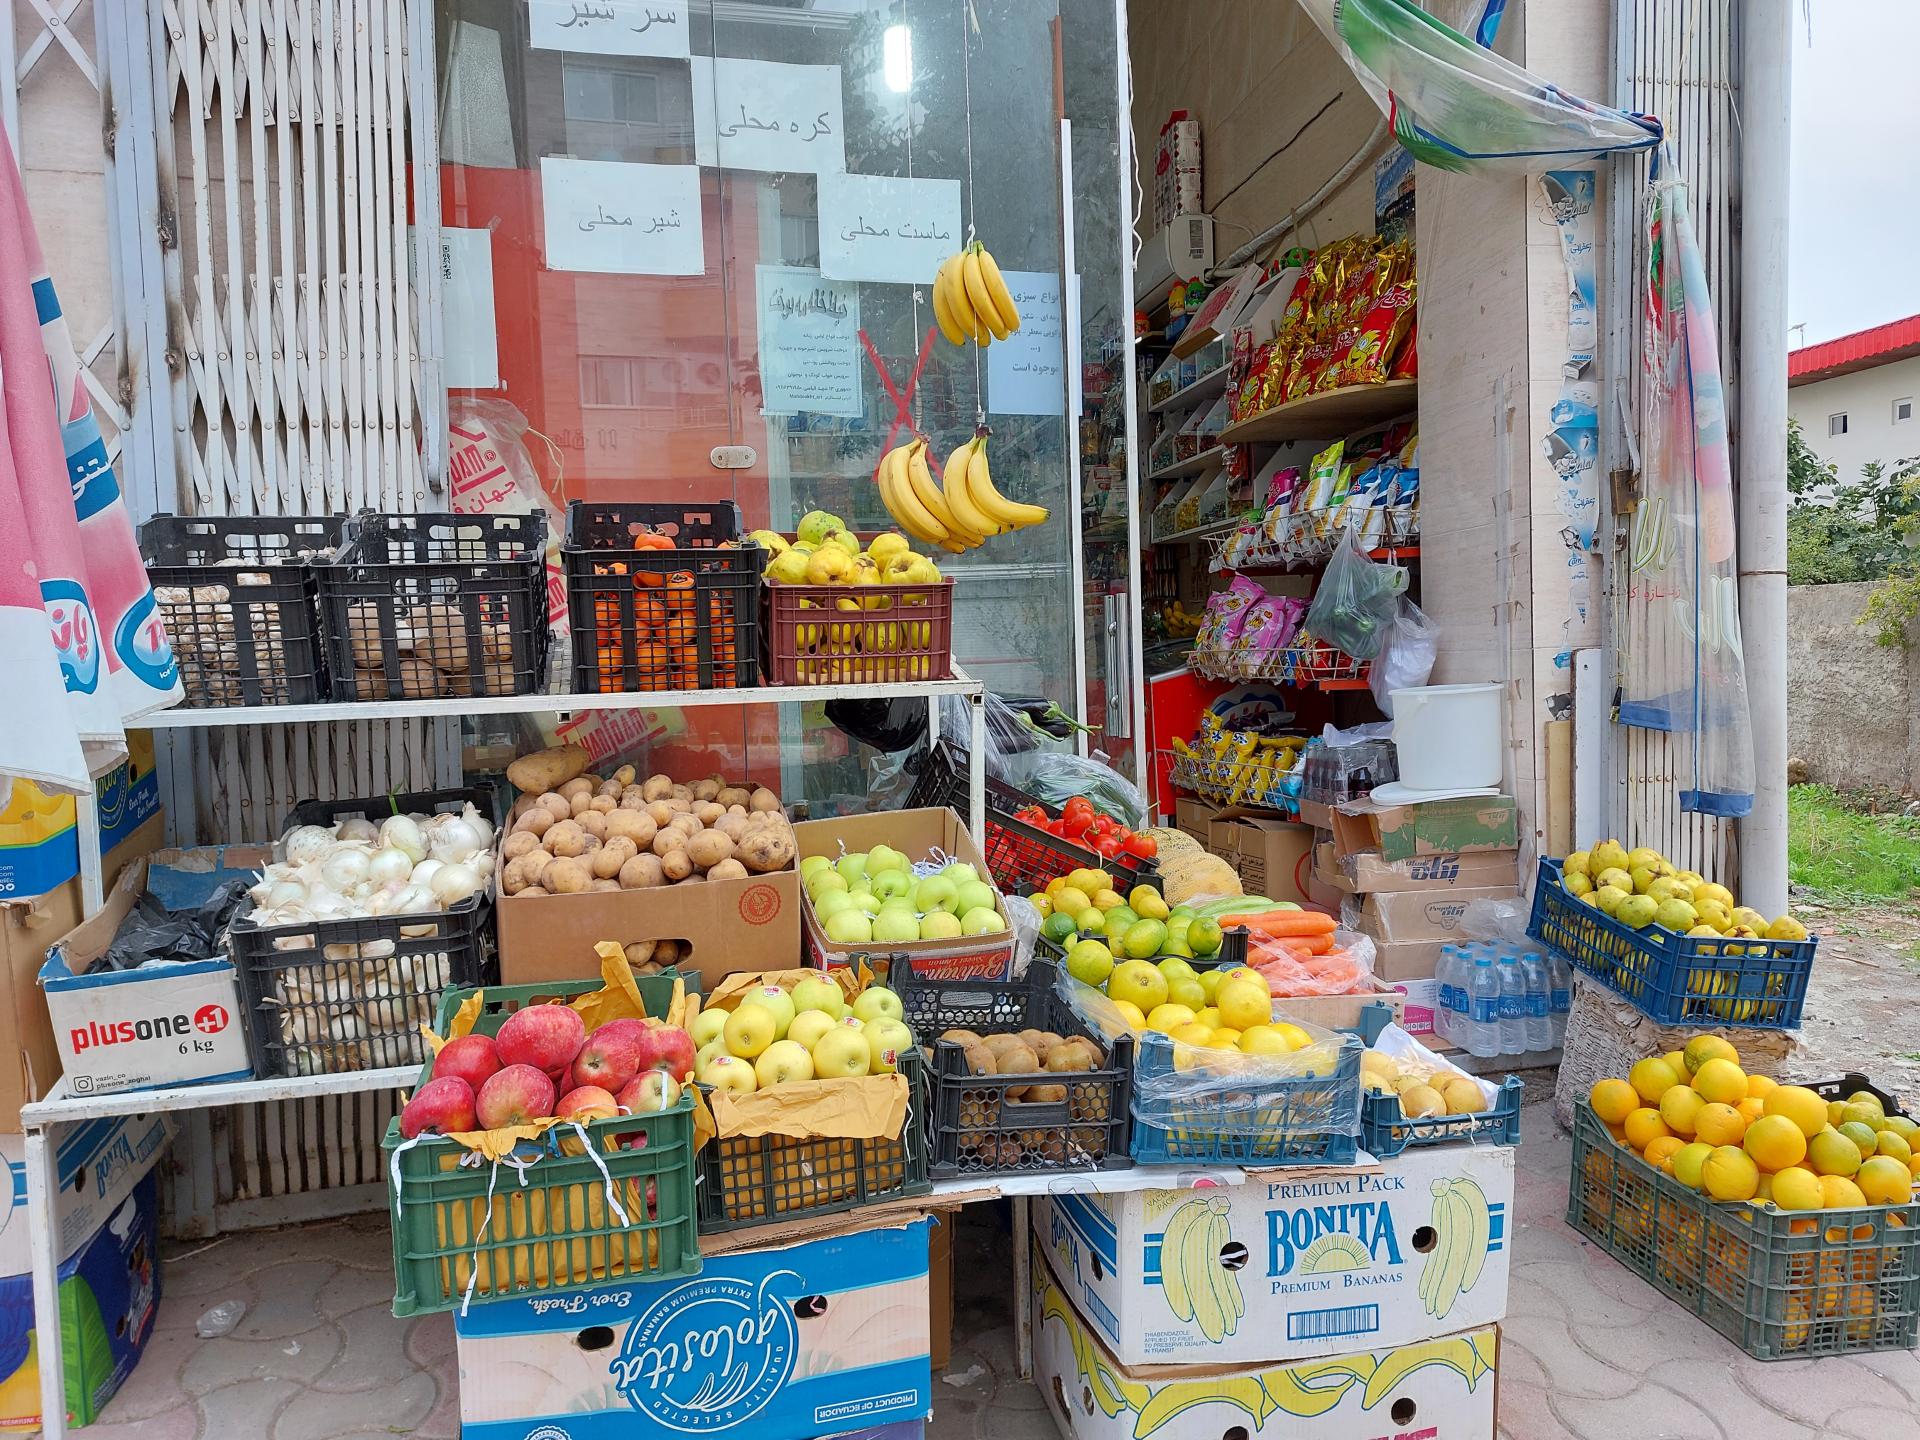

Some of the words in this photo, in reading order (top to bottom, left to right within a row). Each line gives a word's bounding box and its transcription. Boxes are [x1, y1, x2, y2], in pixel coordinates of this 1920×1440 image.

[630, 10, 677, 33] سر
[718, 104, 779, 138] محلی
[789, 111, 832, 142] کره
[578, 204, 633, 232] محلی
[643, 209, 681, 233] شیر
[841, 215, 890, 241] محلی
[898, 221, 950, 241] ماست
[1040, 292, 1060, 303] نواع
[1012, 362, 1031, 372] است
[470, 481, 516, 513] جهان
[70, 1014, 191, 1054] plusone
[178, 1041, 188, 1055] 6
[193, 1039, 214, 1054] kg
[1357, 1175, 1405, 1193] PACK
[1051, 1206, 1083, 1287] BONITA
[1265, 1201, 1404, 1277] BONITA
[720, 1286, 753, 1300] EXTRA
[1271, 1280, 1332, 1295] PREMIUM
[1343, 1272, 1403, 1288] BANANAS
[527, 1295, 588, 1315] Fresh,
[590, 1290, 632, 1307] Ever
[671, 1285, 717, 1307] PREMIUM
[638, 1305, 671, 1349] BANANAS
[744, 1345, 784, 1409] QUALITY
[819, 1405, 861, 1418] ECUADOR
[861, 1402, 873, 1410] OF
[874, 1394, 913, 1408] PRODUCT
[653, 1401, 733, 1425] SELECTED
